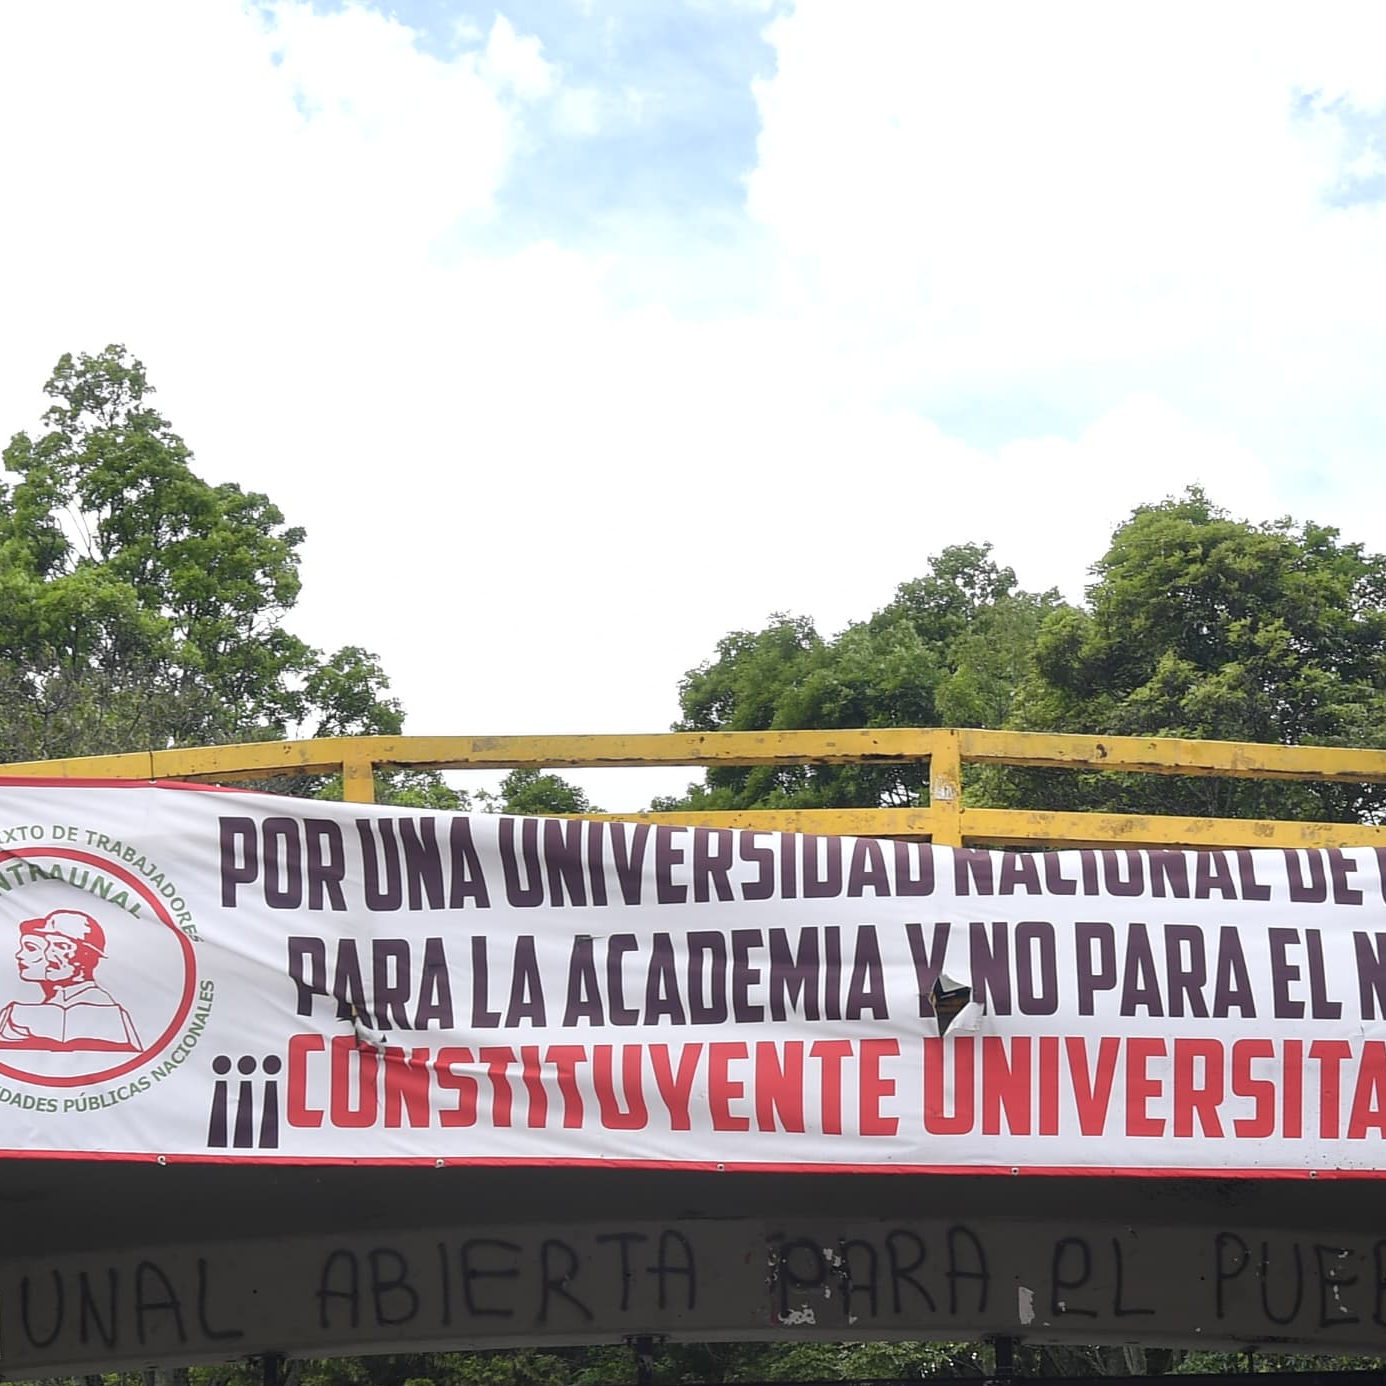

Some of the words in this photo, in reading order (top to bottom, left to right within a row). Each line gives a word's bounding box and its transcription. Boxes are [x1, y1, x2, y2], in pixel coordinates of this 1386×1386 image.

[52, 825, 79, 842] DE
[85, 829, 205, 944] TRABAJADORES
[218, 815, 346, 912] POR
[355, 816, 491, 912] UNA
[497, 816, 936, 909] UNIVERSIDAD
[1281, 846, 1364, 908] DE
[287, 935, 455, 1031] PARA
[471, 934, 548, 1031] LA
[562, 922, 891, 1028] ACADEMIA
[905, 921, 953, 1019] Y
[969, 920, 1060, 1018] NO
[1075, 920, 1258, 1020] PARA
[1267, 925, 1344, 1023] EL
[63, 1076, 152, 1113] PÚBLICAS
[150, 979, 215, 1082] NACIONALES
[21, 1257, 245, 1349] UNAL
[315, 1228, 698, 1330] ABIERTA
[766, 1225, 992, 1319] PARA
